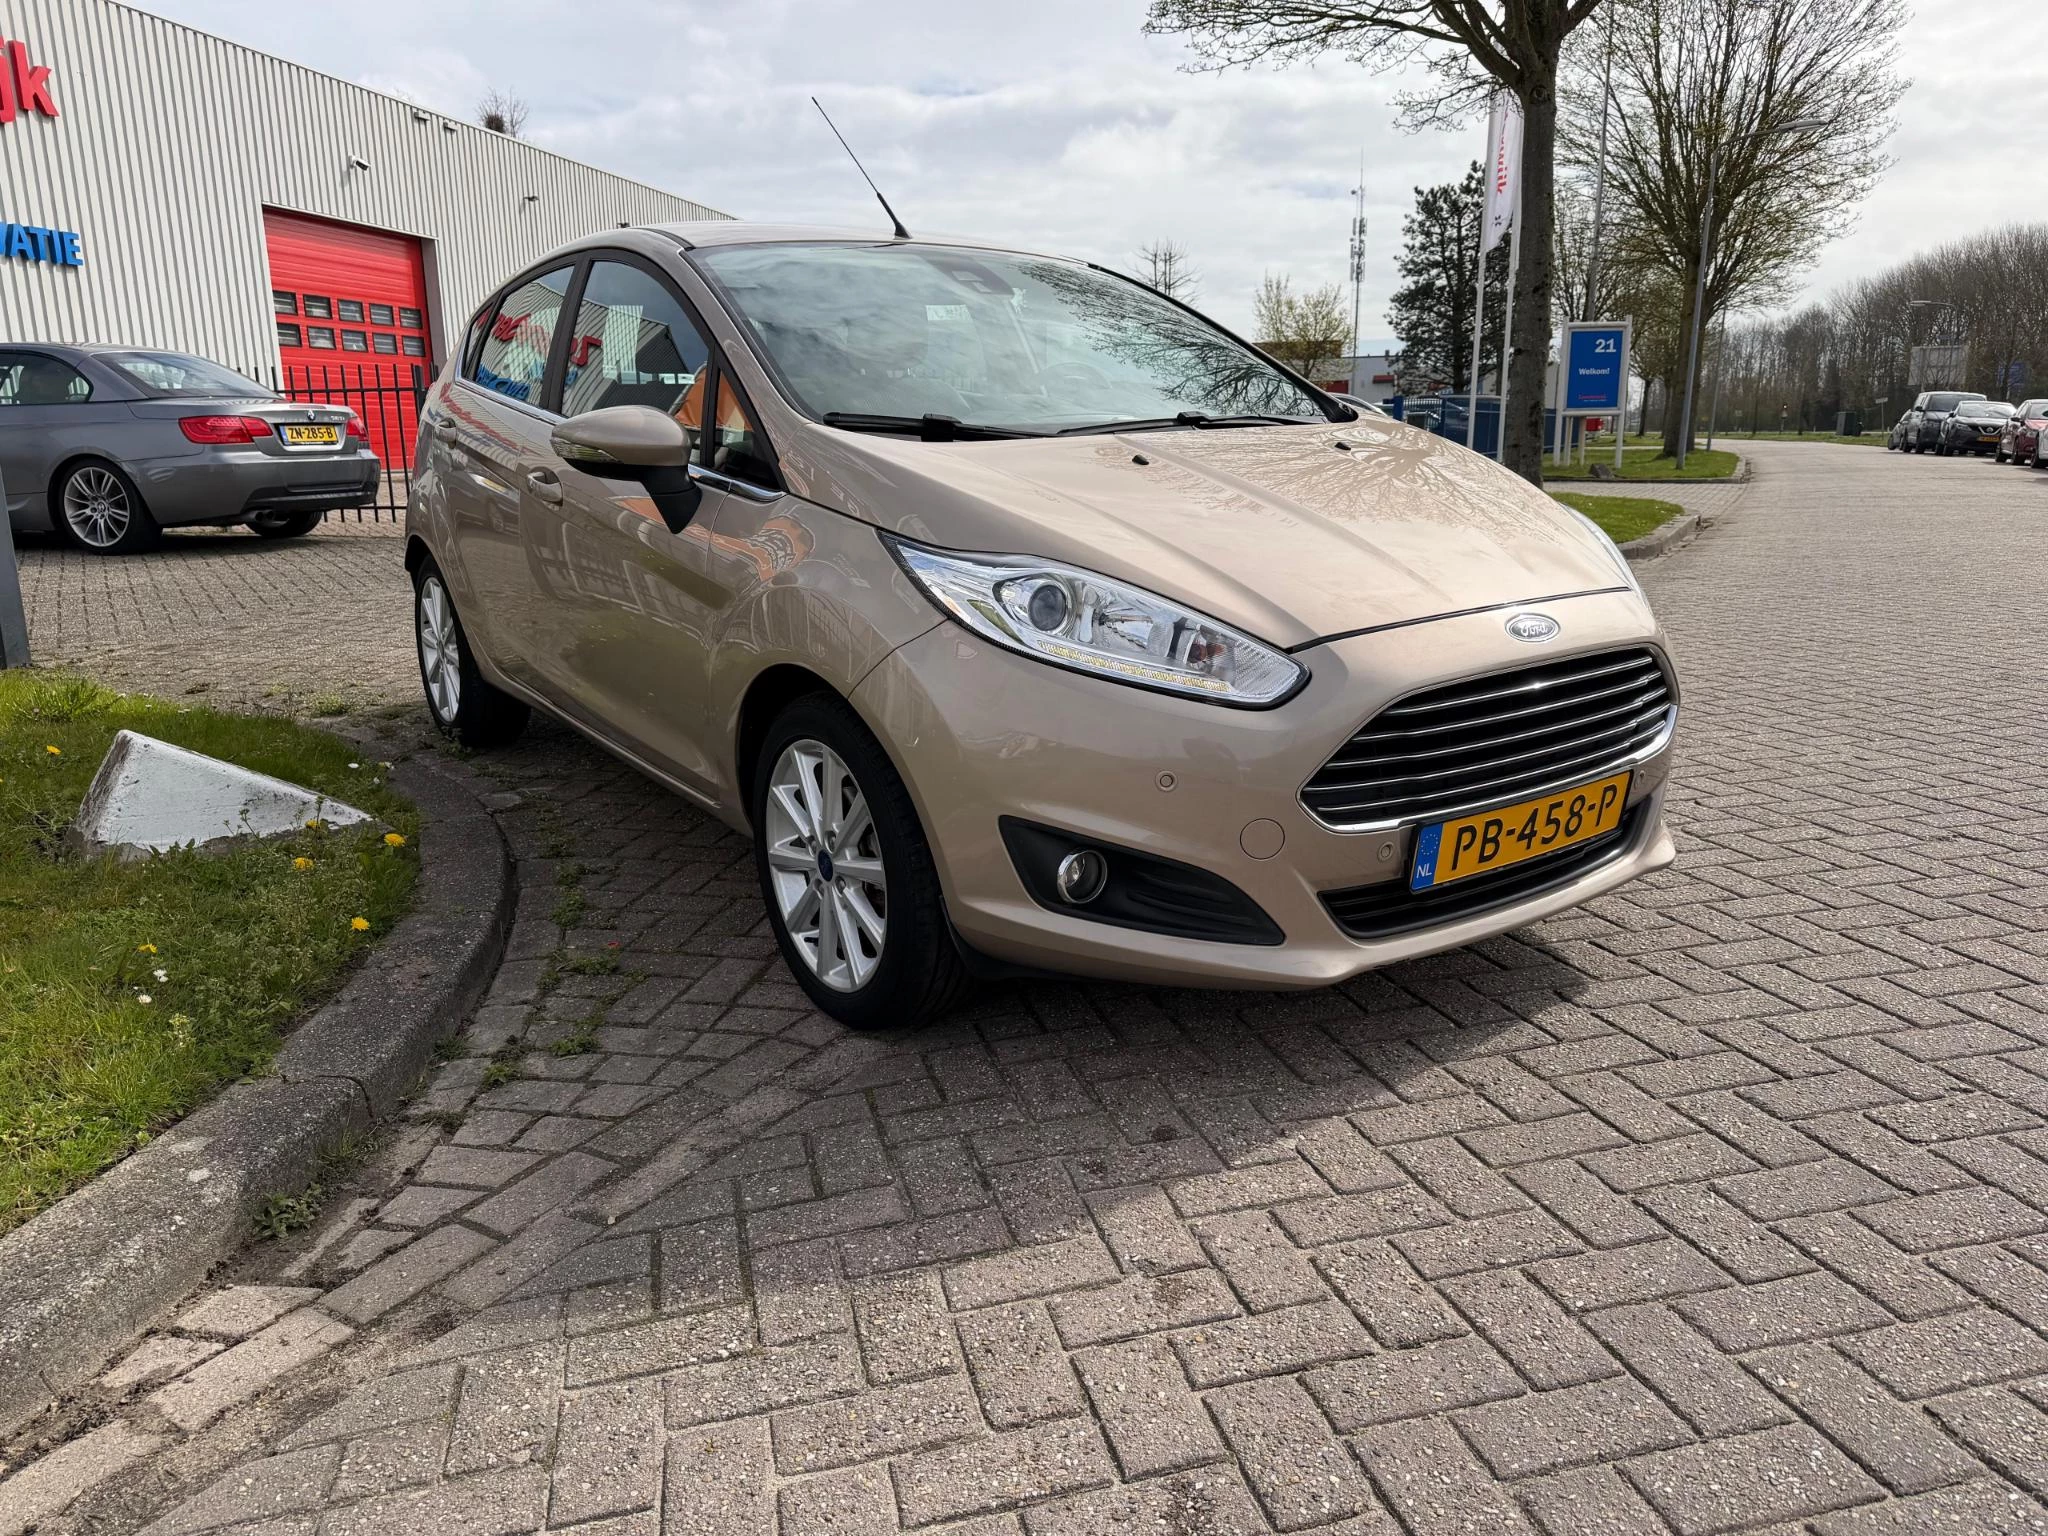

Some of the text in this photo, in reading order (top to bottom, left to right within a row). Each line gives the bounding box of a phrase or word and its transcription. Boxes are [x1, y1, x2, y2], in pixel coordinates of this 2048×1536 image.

[1594, 338, 1617, 353] 21
[1578, 367, 1610, 375] Welkom!
[287, 425, 334, 440] ZN-285-B
[1517, 620, 1549, 637] Ford
[1450, 783, 1618, 871] PB-458-P
[1415, 864, 1433, 879] NL
